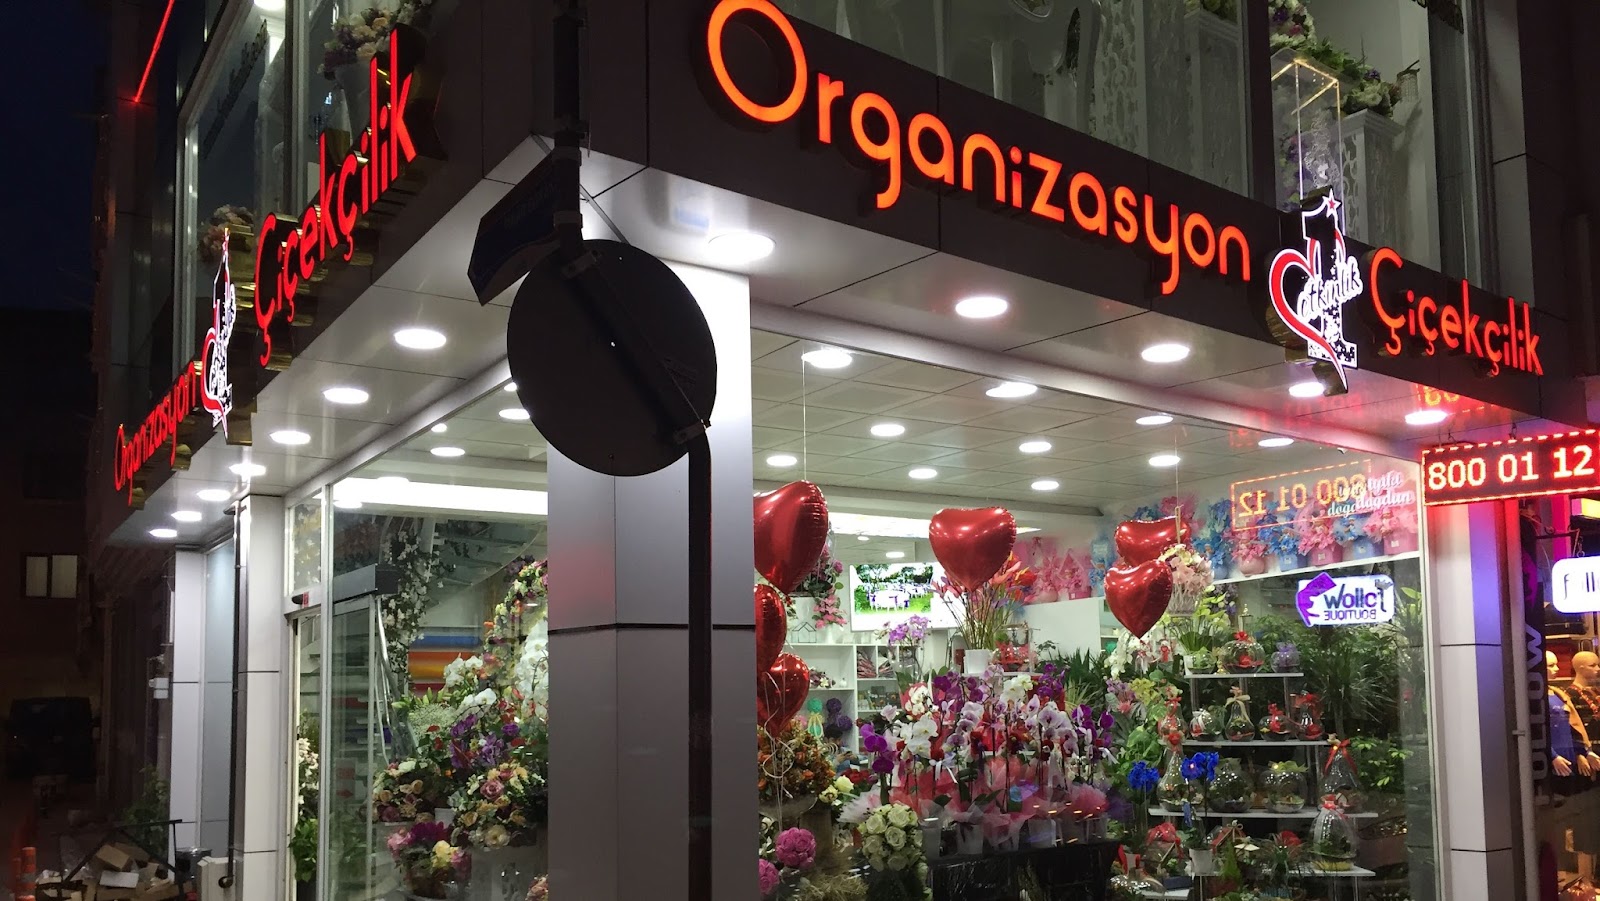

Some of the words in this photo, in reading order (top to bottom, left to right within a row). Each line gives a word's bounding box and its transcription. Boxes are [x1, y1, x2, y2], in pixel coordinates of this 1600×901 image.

[254, 28, 417, 367] Çiçekçilik
[707, 0, 1251, 295] Organizasyon
[1370, 246, 1544, 376] Çiçekçilik
[114, 361, 197, 506] Organizasyon
[1428, 457, 1487, 491] 800
[1497, 451, 1539, 483] 01
[1553, 444, 1595, 479] 12
[1525, 622, 1549, 807] FOLLOW
